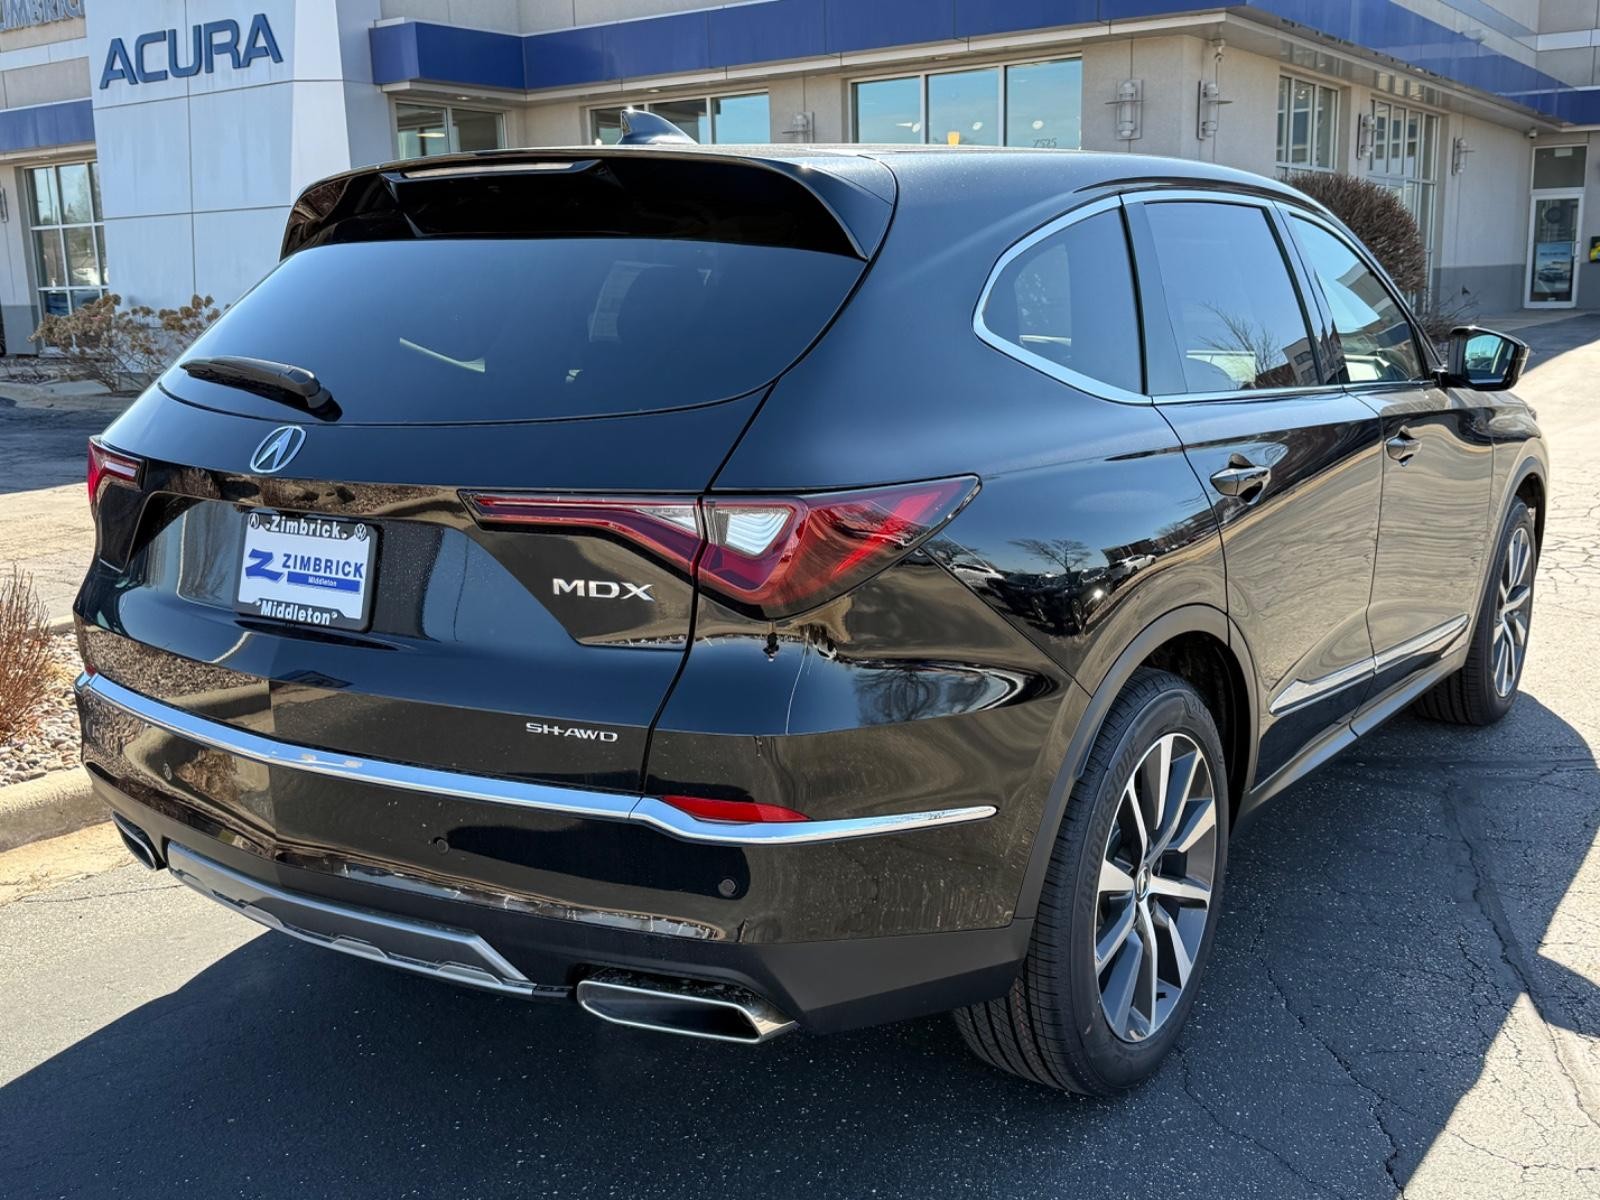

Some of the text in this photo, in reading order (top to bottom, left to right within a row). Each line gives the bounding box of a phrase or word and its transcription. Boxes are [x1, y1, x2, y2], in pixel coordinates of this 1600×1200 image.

[0, 0, 85, 32] IMBRIC
[100, 13, 284, 90] ACURA
[269, 515, 341, 538] Zimbrick
[282, 553, 364, 579] ZIMBRICK
[308, 576, 337, 588] Middleton
[552, 578, 655, 602] MDX
[260, 600, 330, 625] Middleton
[526, 722, 618, 742] SH-AWD
[1078, 735, 1138, 914] BRIDGESTONE
